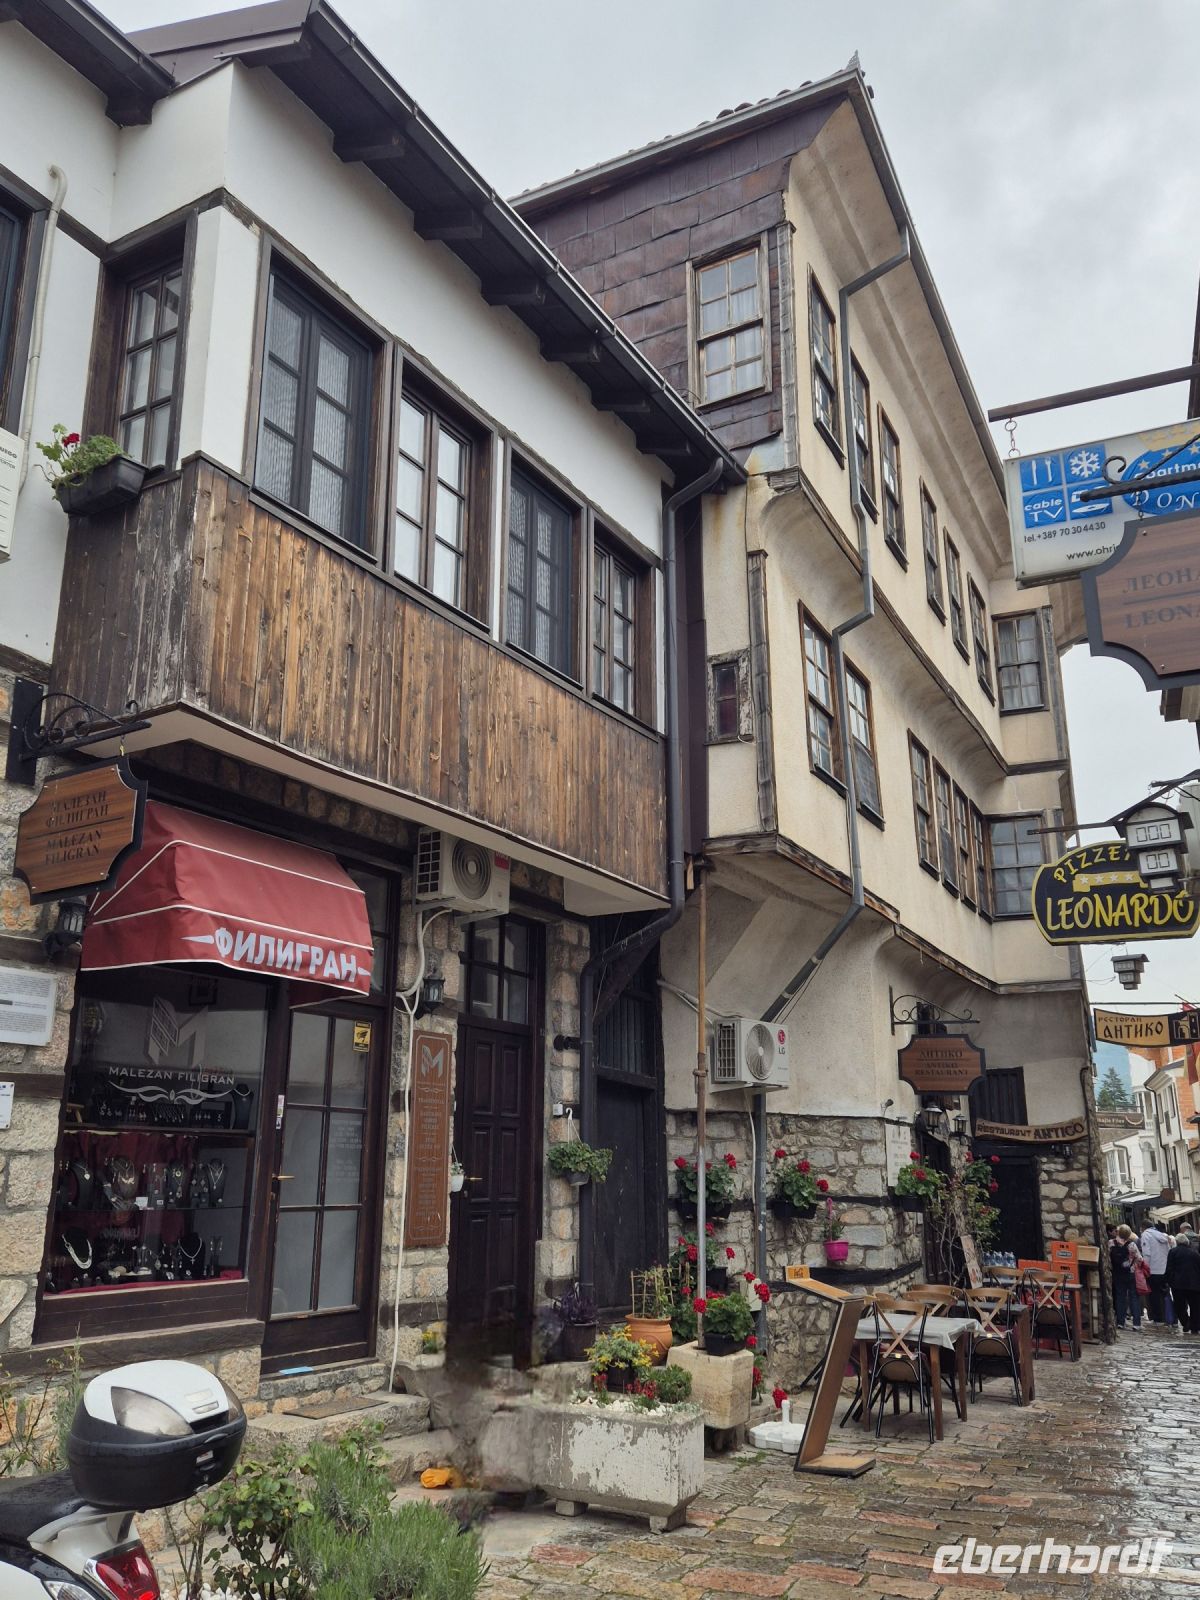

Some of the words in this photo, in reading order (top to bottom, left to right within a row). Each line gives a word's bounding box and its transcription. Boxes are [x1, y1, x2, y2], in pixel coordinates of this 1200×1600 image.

[1025, 498, 1062, 511] cable
[1029, 506, 1064, 522] TV
[1122, 567, 1200, 593] ЛЕОН
[1124, 602, 1200, 629] LEON
[48, 829, 102, 849] MALEZAN
[45, 845, 100, 865] FILIGRAN
[1046, 891, 1194, 931] LEONARDO
[215, 927, 357, 982] ФИЛИГРАН
[1103, 1021, 1164, 1039] АНТИКО
[778, 1047, 786, 1055] LG
[108, 1066, 173, 1080] MALEZAN
[178, 1072, 235, 1085] FILIGRAN
[1033, 1122, 1085, 1139] ANTICO
